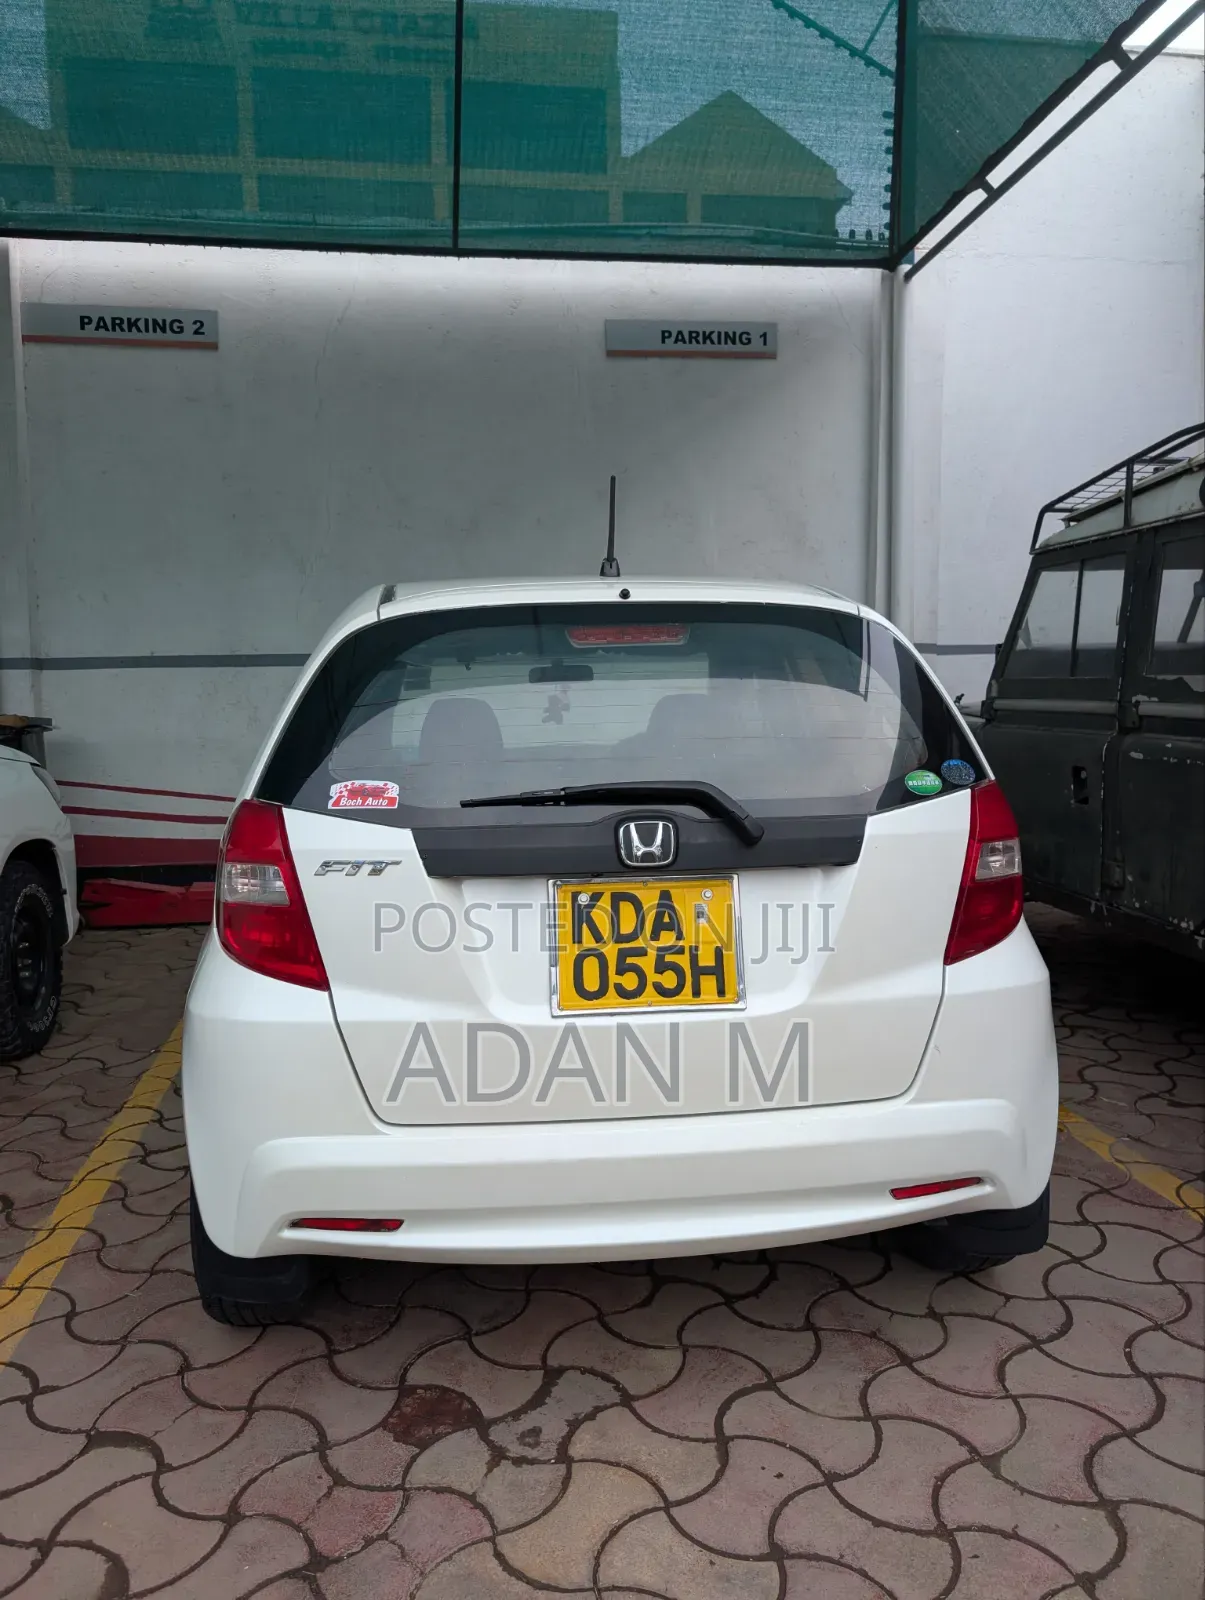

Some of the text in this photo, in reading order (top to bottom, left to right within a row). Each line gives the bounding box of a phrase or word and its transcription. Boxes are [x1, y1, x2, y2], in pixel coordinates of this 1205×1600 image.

[79, 315, 206, 335] PARKING 2
[660, 330, 768, 346] PARKING 1
[340, 797, 388, 806] Boch Auto
[314, 860, 402, 876] FIT
[571, 889, 686, 944] KDA
[573, 945, 726, 1001] 055H
